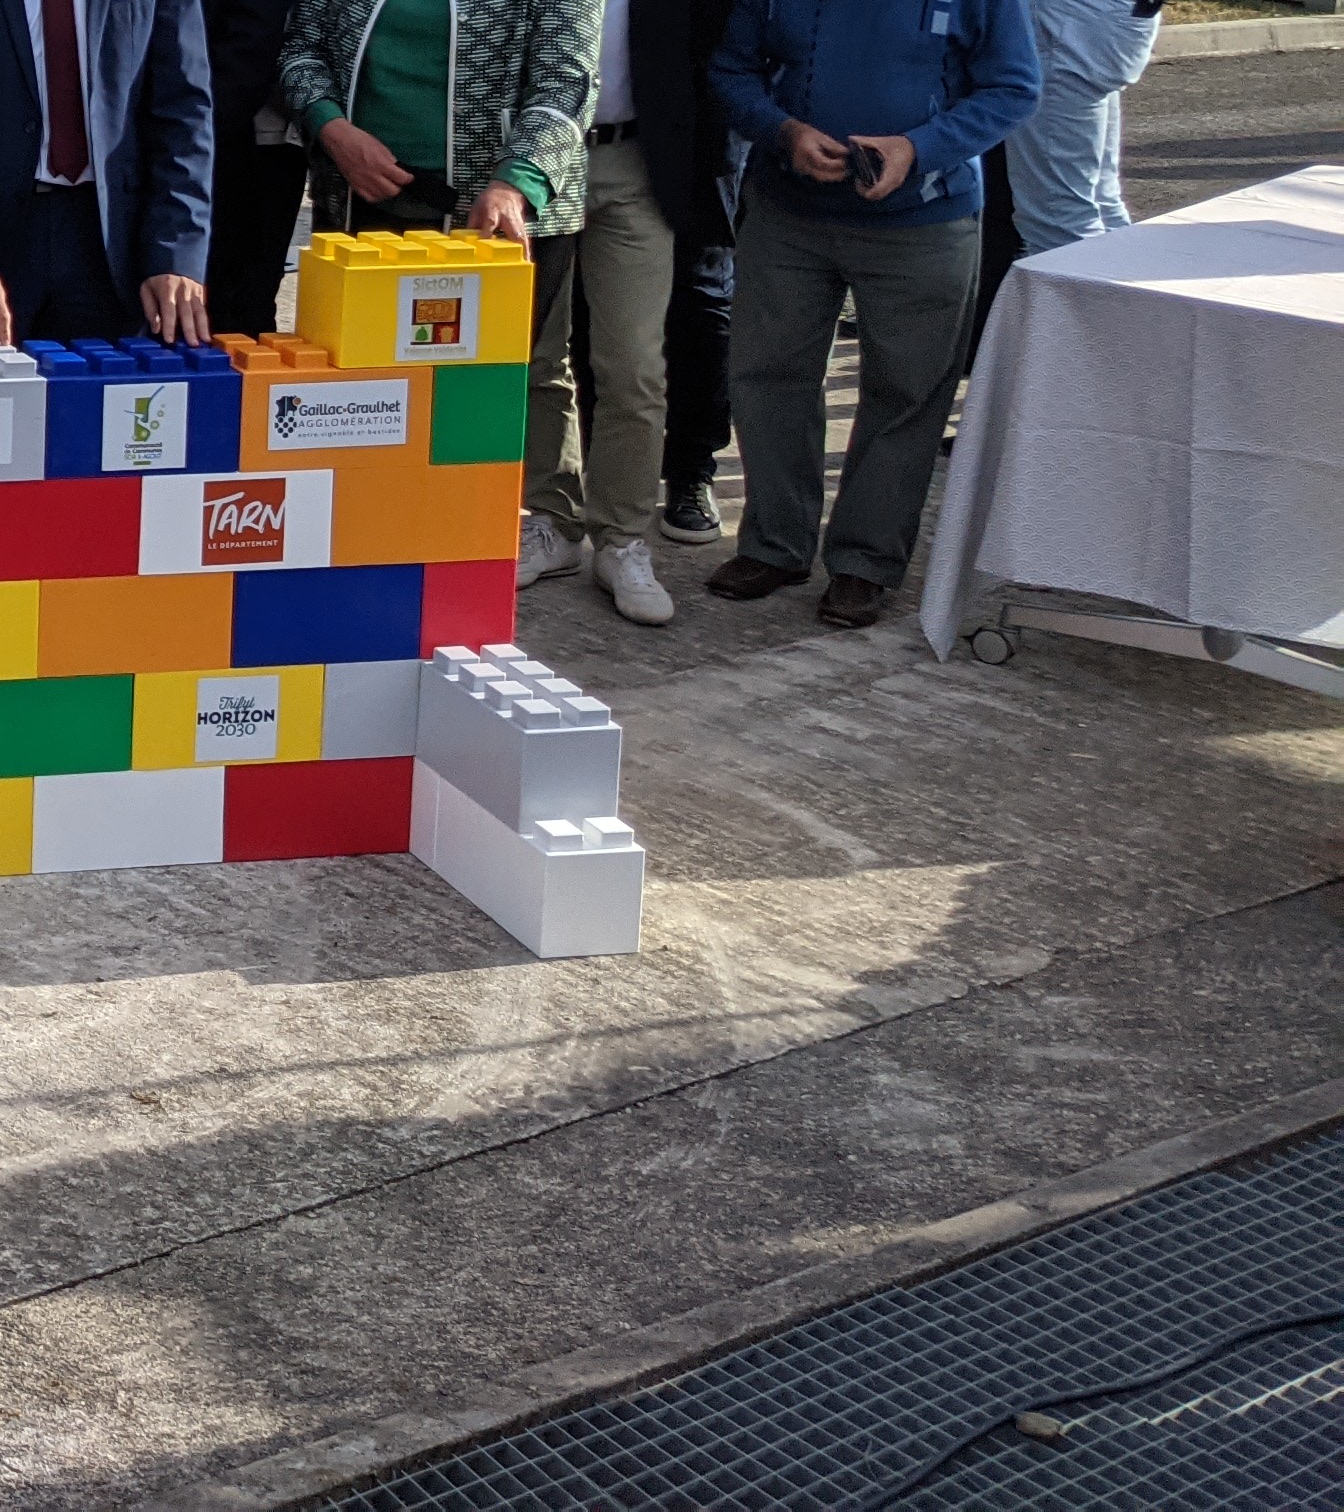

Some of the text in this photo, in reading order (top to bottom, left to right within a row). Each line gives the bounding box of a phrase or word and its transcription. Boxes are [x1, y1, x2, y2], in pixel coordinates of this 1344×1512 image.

[202, 491, 287, 540] TARN
[219, 539, 279, 549] DÉPARTEMENT
[218, 696, 255, 710] Trifyl
[197, 709, 275, 726] HORIZON
[215, 723, 257, 738] 2030
